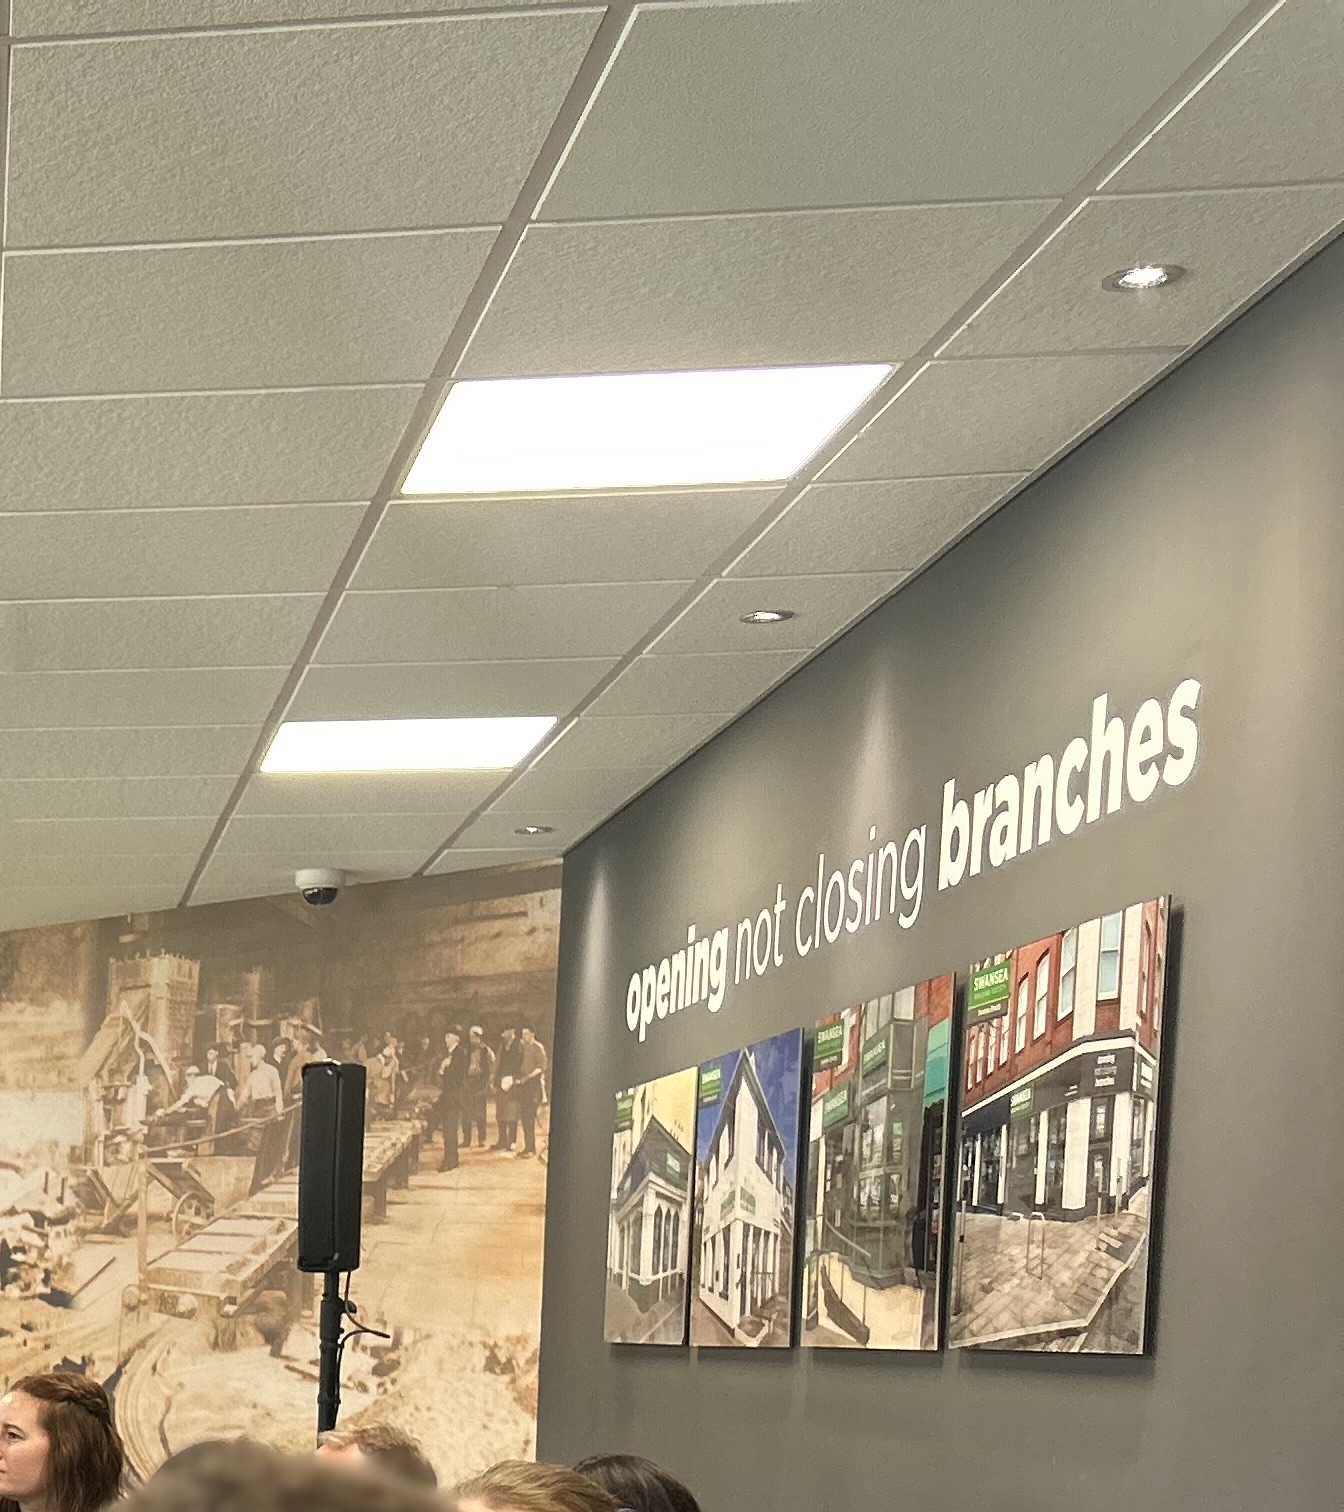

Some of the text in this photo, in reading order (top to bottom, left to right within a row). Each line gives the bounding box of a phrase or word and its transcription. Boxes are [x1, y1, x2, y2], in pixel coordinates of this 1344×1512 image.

[625, 677, 1203, 1044] opening not closing branches
[973, 967, 1009, 992] SWANSEA
